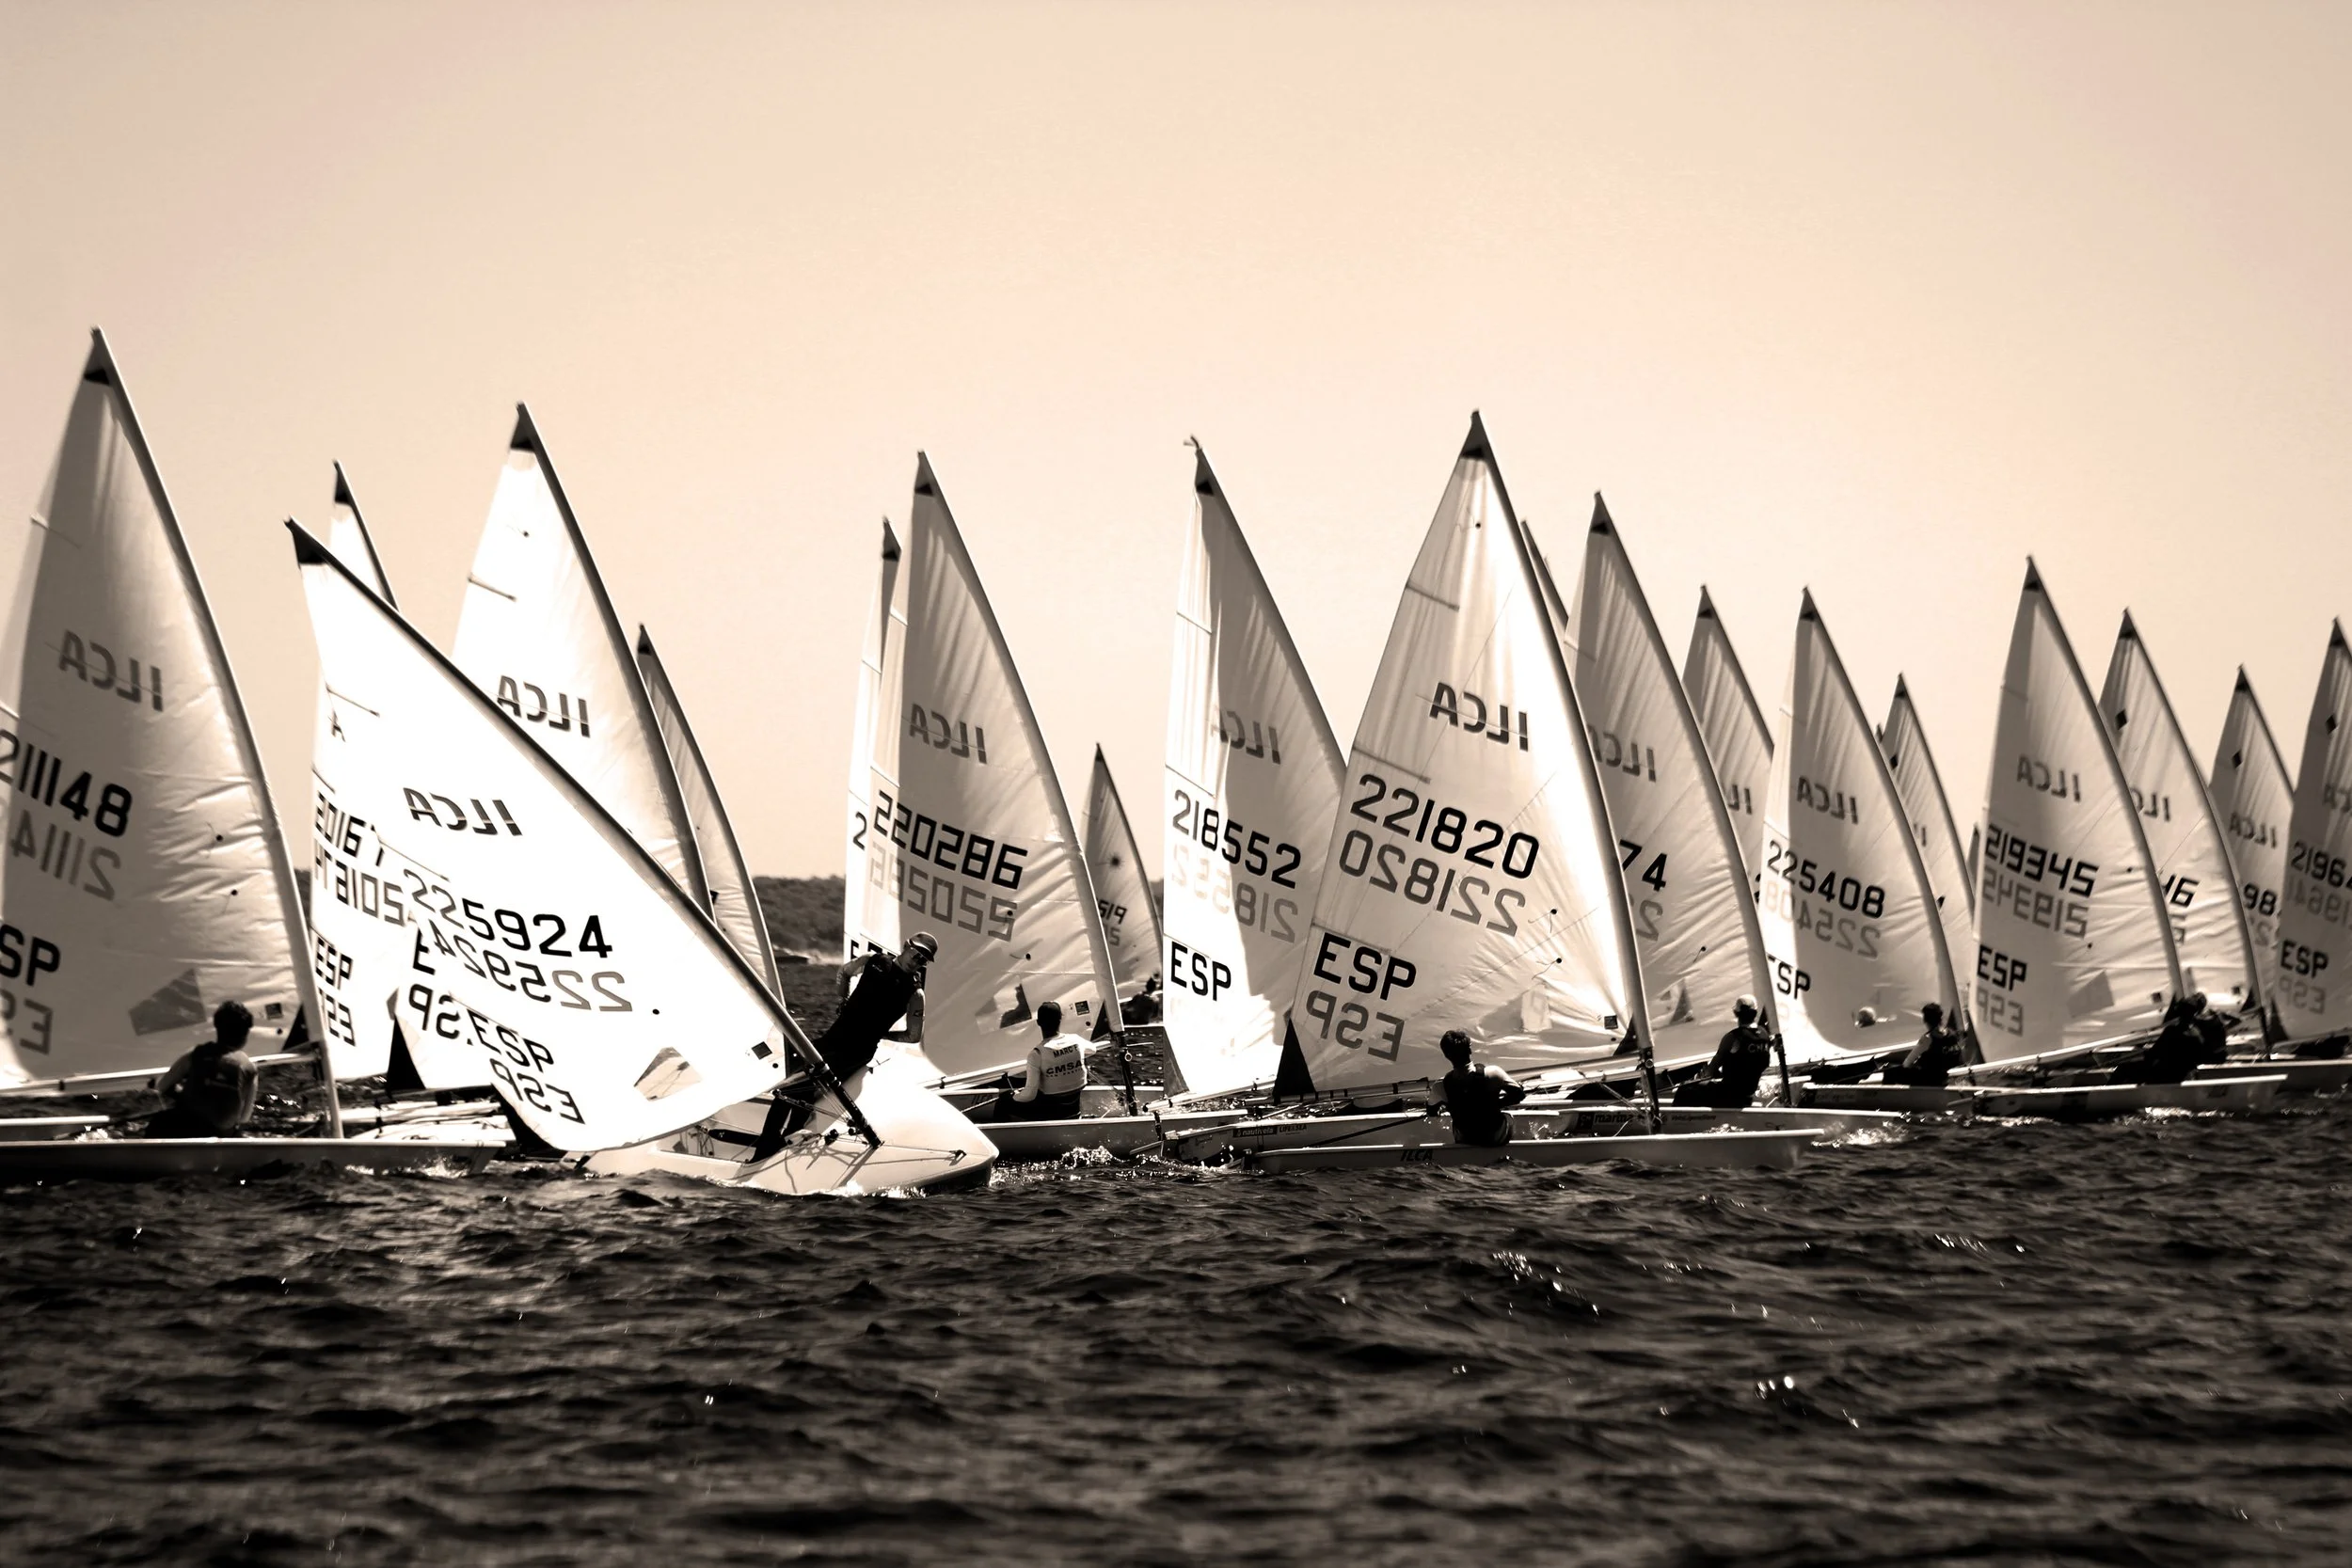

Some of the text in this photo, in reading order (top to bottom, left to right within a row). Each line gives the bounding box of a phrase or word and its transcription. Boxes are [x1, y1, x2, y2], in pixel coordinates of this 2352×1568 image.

[0, 728, 133, 838] 211148
[873, 789, 1028, 890] 220286
[1171, 789, 1302, 889] 218552
[1350, 773, 1540, 879] 221820
[1984, 821, 2100, 899] 219345
[403, 867, 613, 958] 225924
[1096, 898, 1127, 926] 519
[1767, 839, 1885, 920] 225408
[0, 923, 61, 987] SP
[315, 936, 354, 990] ESP
[1170, 940, 1232, 1001] ESP
[1313, 931, 1417, 1001] ESP
[1977, 943, 2028, 992] ESP
[2280, 940, 2329, 979] ESP
[467, 1007, 555, 1073] ESP
